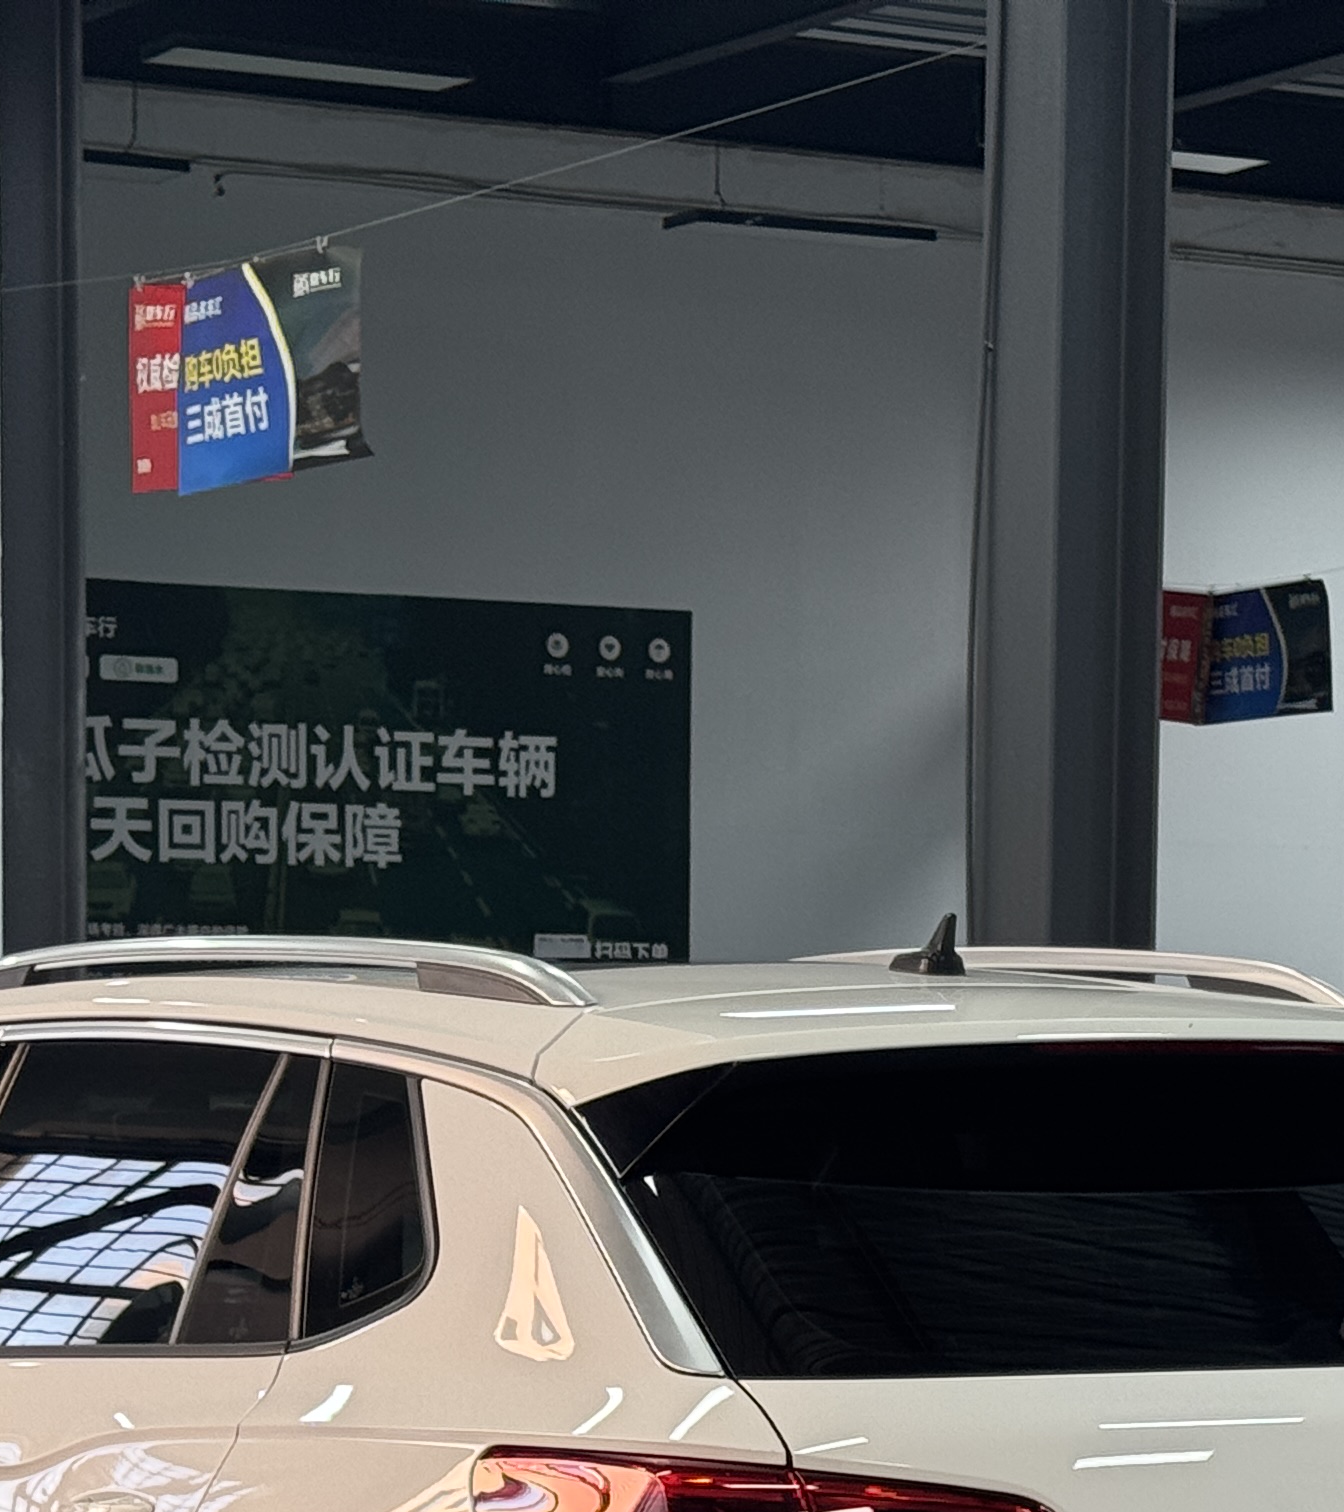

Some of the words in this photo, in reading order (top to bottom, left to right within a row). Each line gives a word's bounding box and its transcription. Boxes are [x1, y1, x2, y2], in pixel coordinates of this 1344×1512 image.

[184, 338, 264, 392] 购车0负担
[186, 387, 269, 444] 三成首付
[90, 797, 403, 869] 天回购保障
